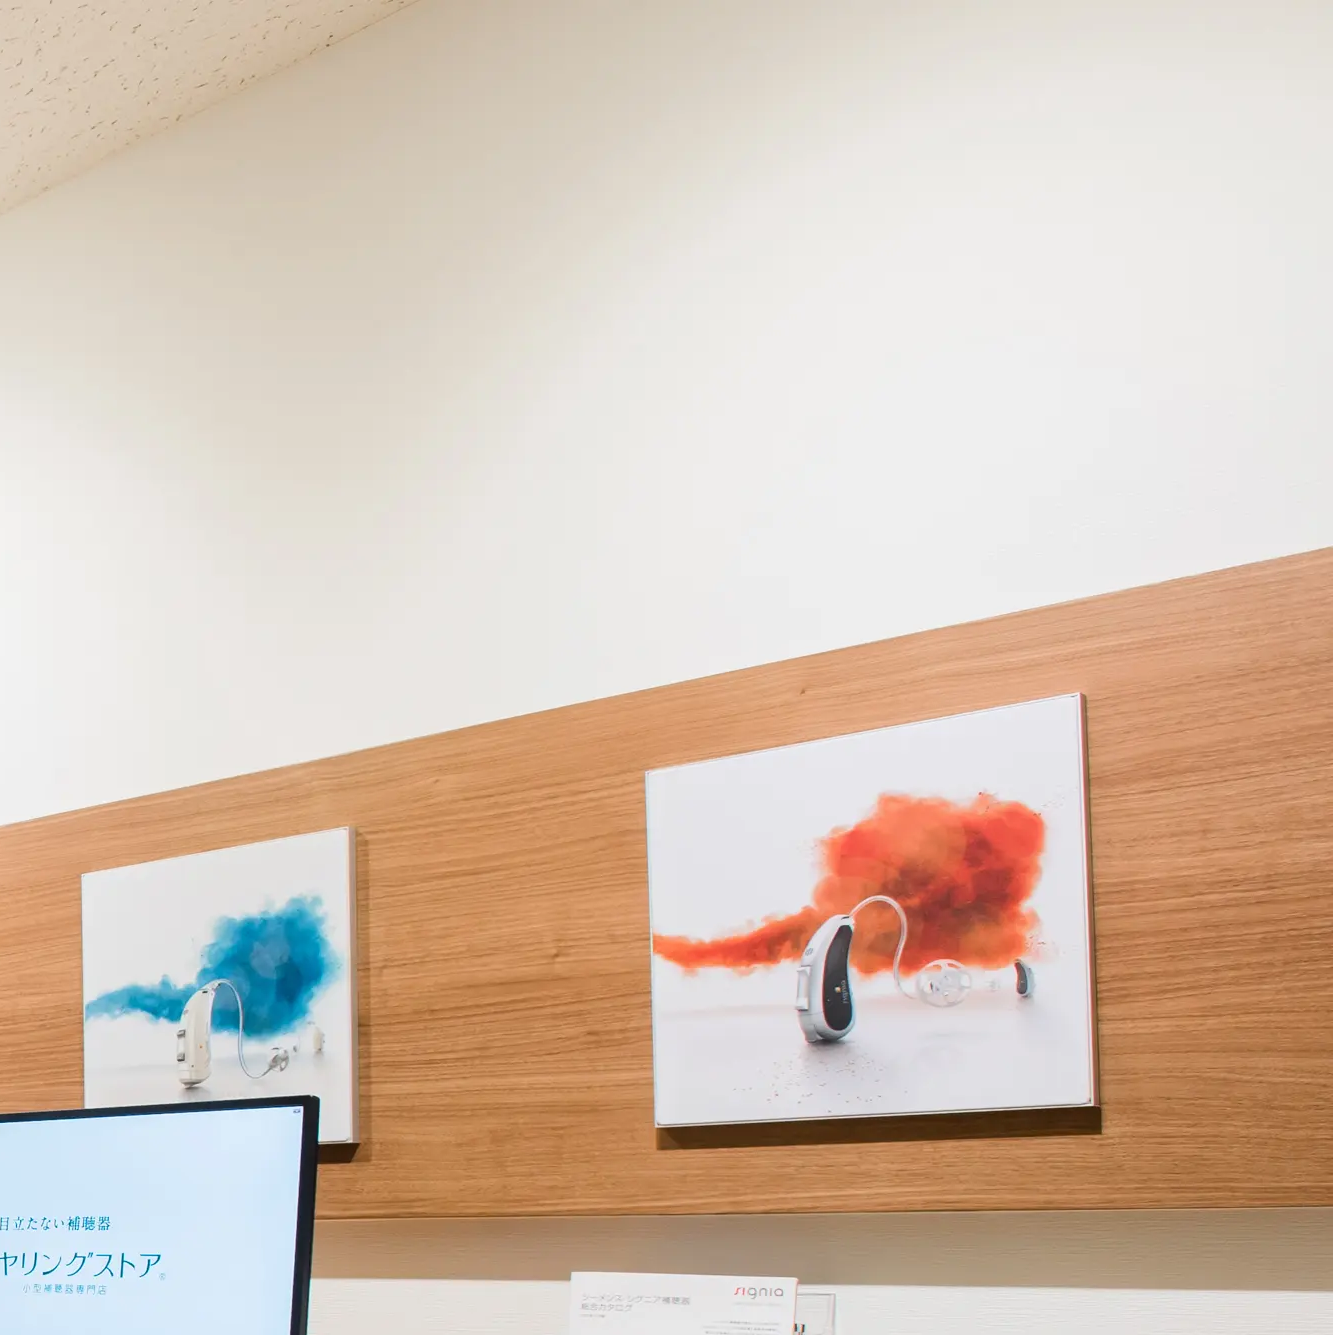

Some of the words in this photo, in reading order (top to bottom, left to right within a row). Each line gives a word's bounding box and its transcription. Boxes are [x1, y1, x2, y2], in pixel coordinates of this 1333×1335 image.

[22, 1284, 108, 1296] 小型補聴器専門店
[734, 1287, 784, 1299] signia
